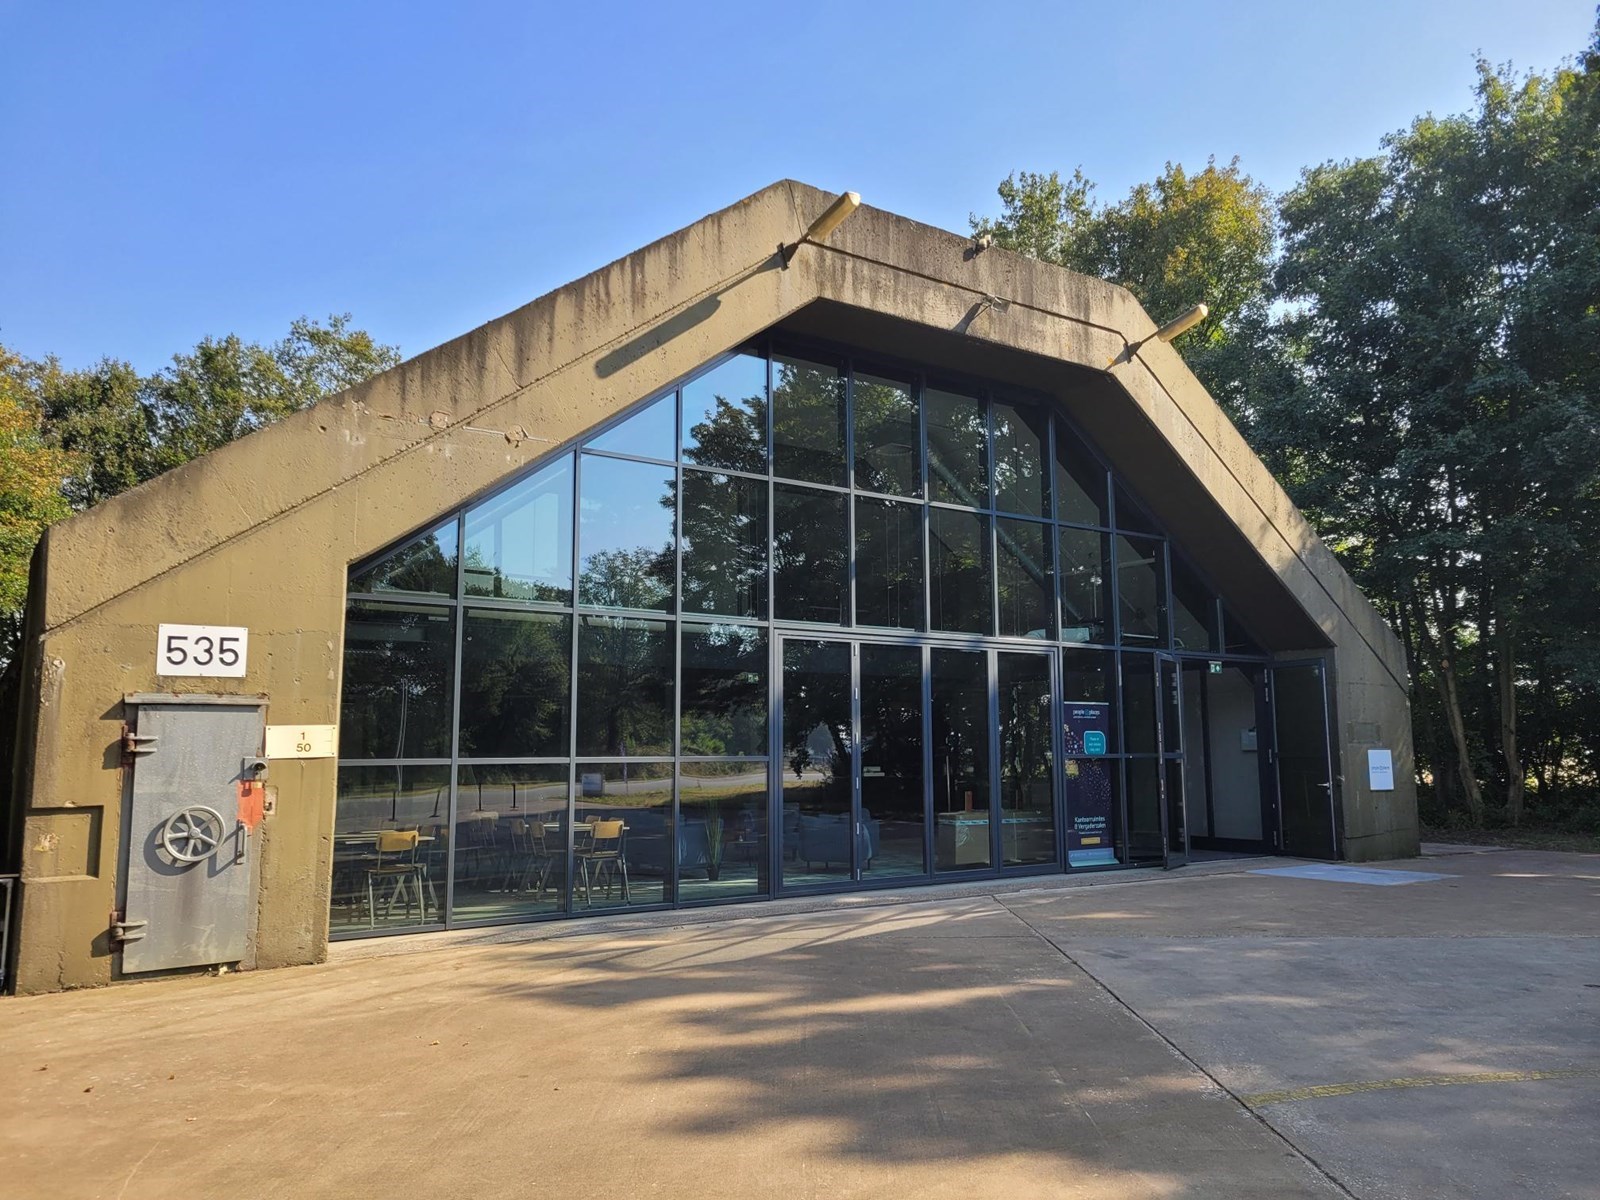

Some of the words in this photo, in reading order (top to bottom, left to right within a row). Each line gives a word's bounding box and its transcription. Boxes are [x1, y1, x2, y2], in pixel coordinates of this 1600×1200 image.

[166, 635, 239, 667] 535
[300, 732, 305, 740] 1
[296, 743, 312, 752] 50
